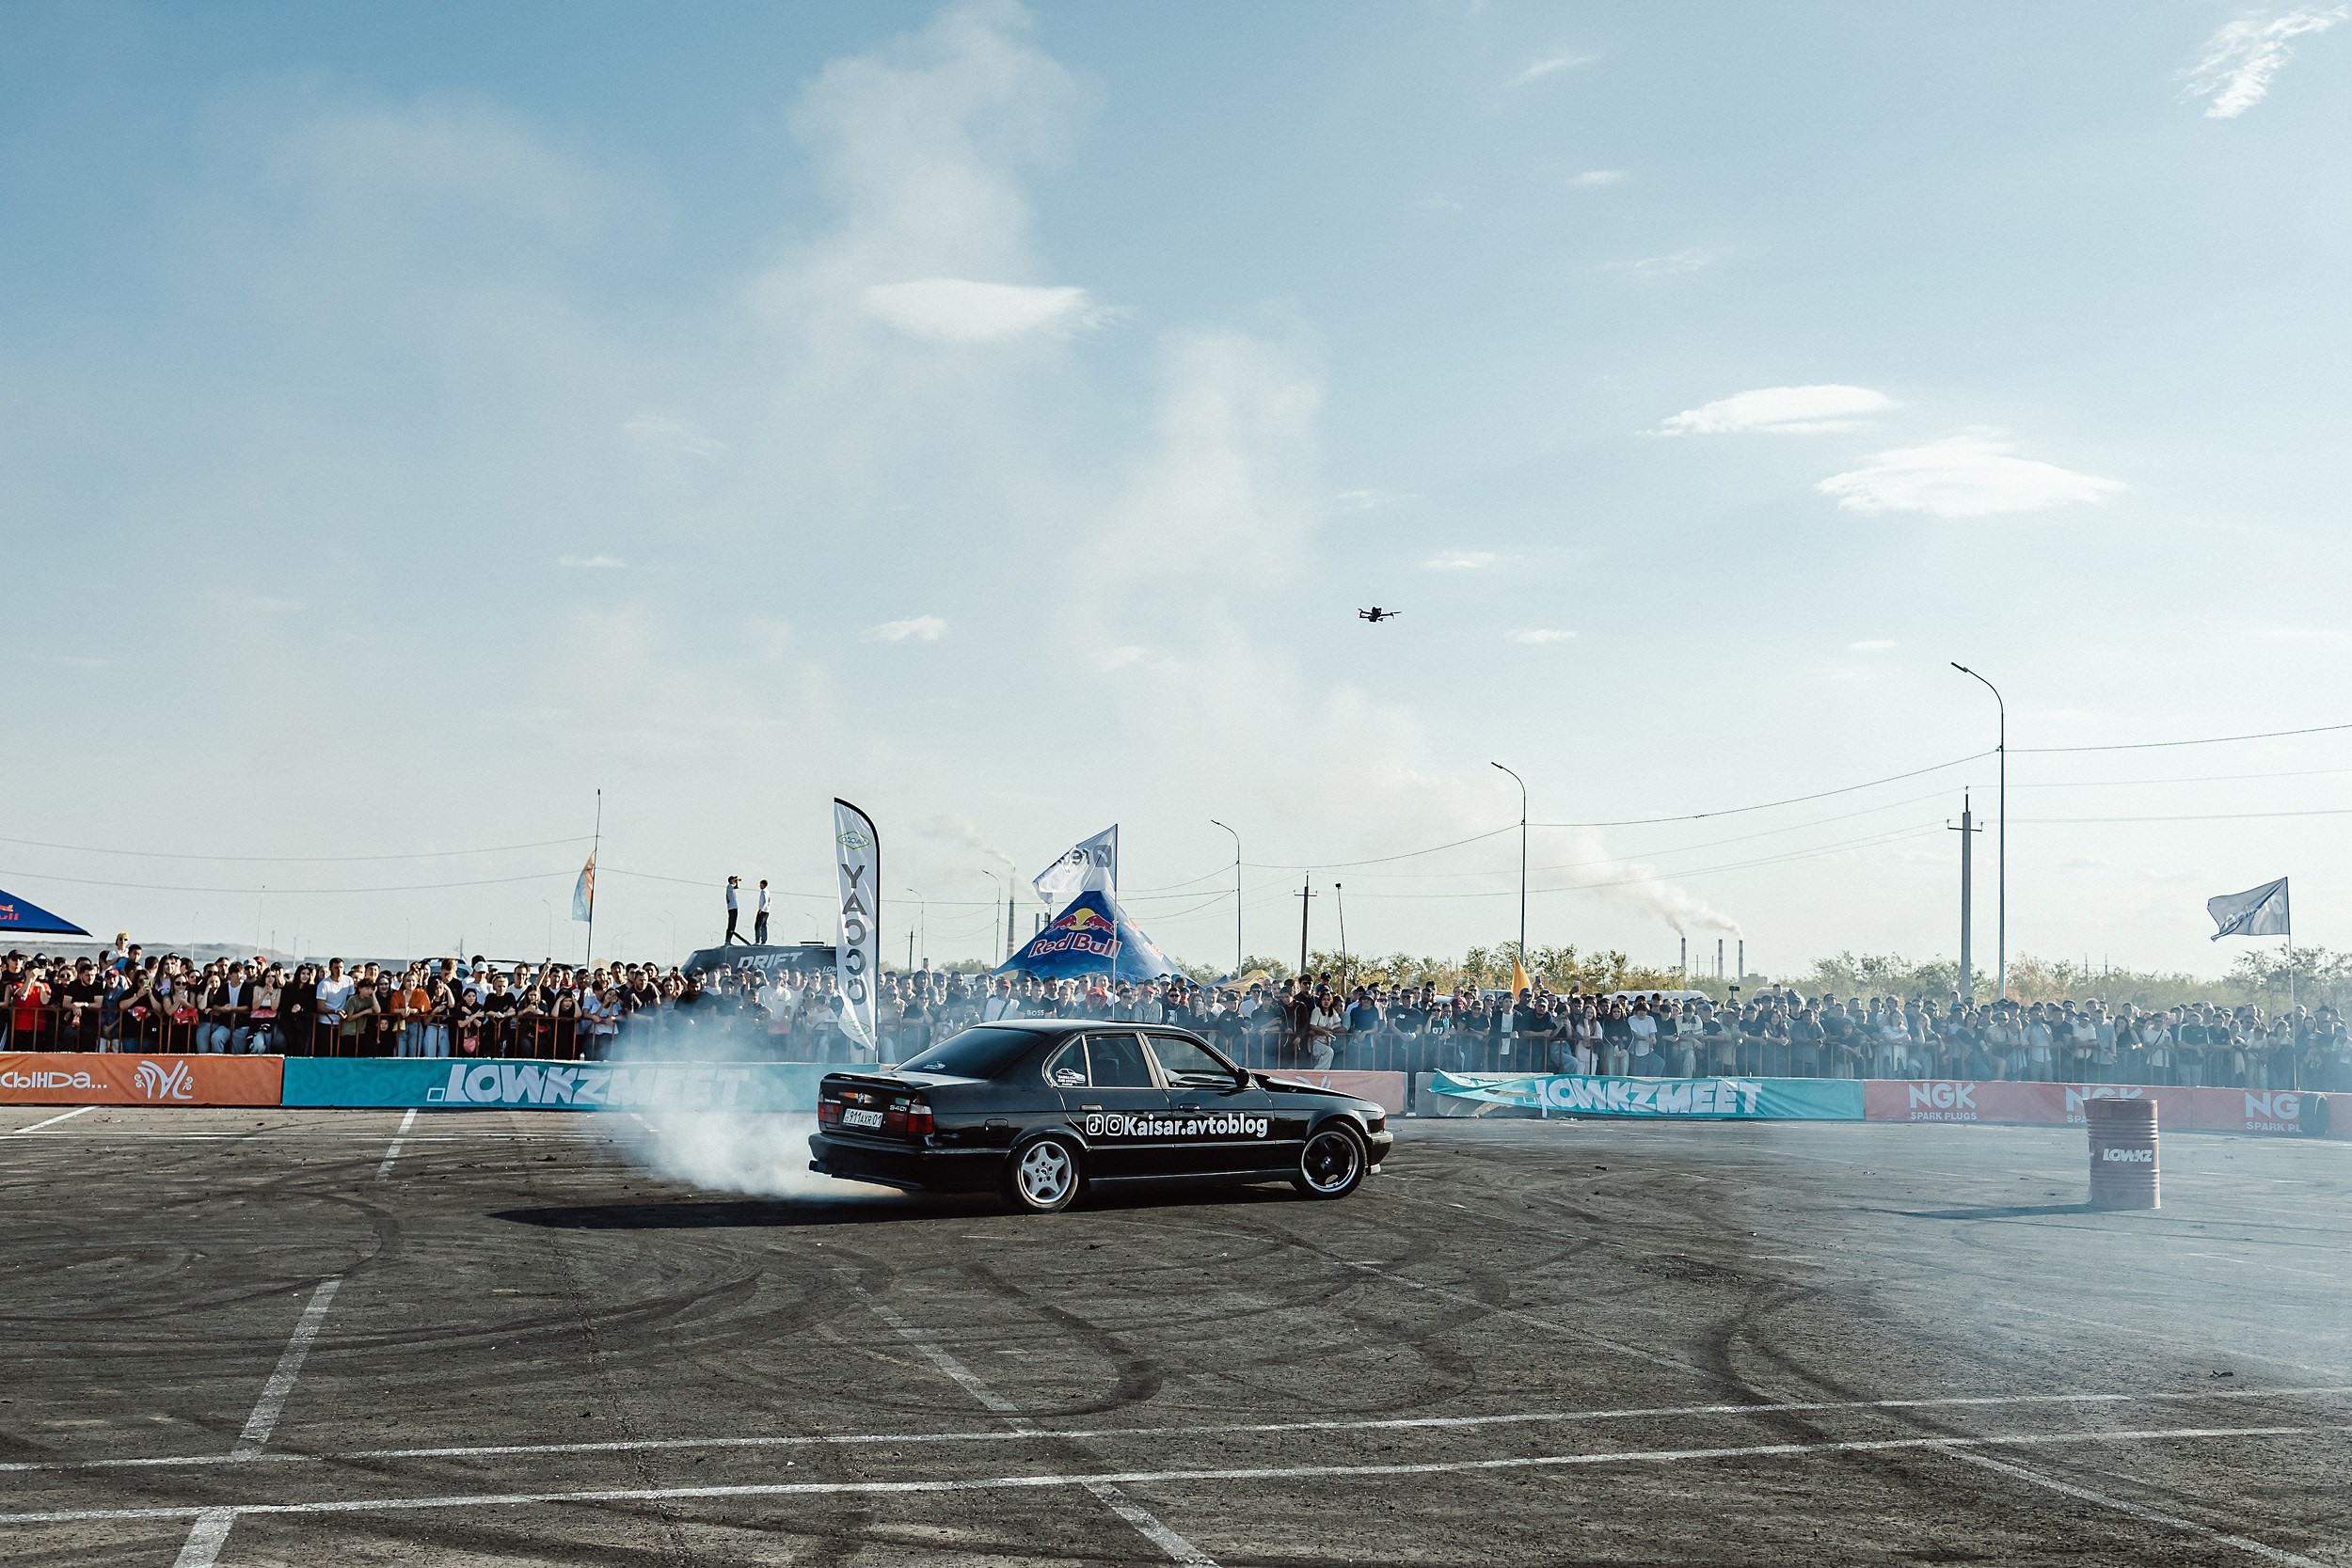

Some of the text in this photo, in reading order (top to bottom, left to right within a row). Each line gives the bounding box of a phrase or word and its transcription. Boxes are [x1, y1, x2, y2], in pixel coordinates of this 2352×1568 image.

[1028, 932, 1074, 958] Red
[1070, 932, 1122, 959] Bull
[737, 951, 803, 970] DRIFT
[1908, 1083, 1978, 1109] NGK
[2245, 1091, 2300, 1120] NG
[1123, 1113, 1268, 1138] Kaisar.avtoblog
[1910, 1112, 1978, 1120] SPARK PLUGS
[2067, 1115, 2088, 1123] SPA
[2246, 1121, 2285, 1132] SPARK
